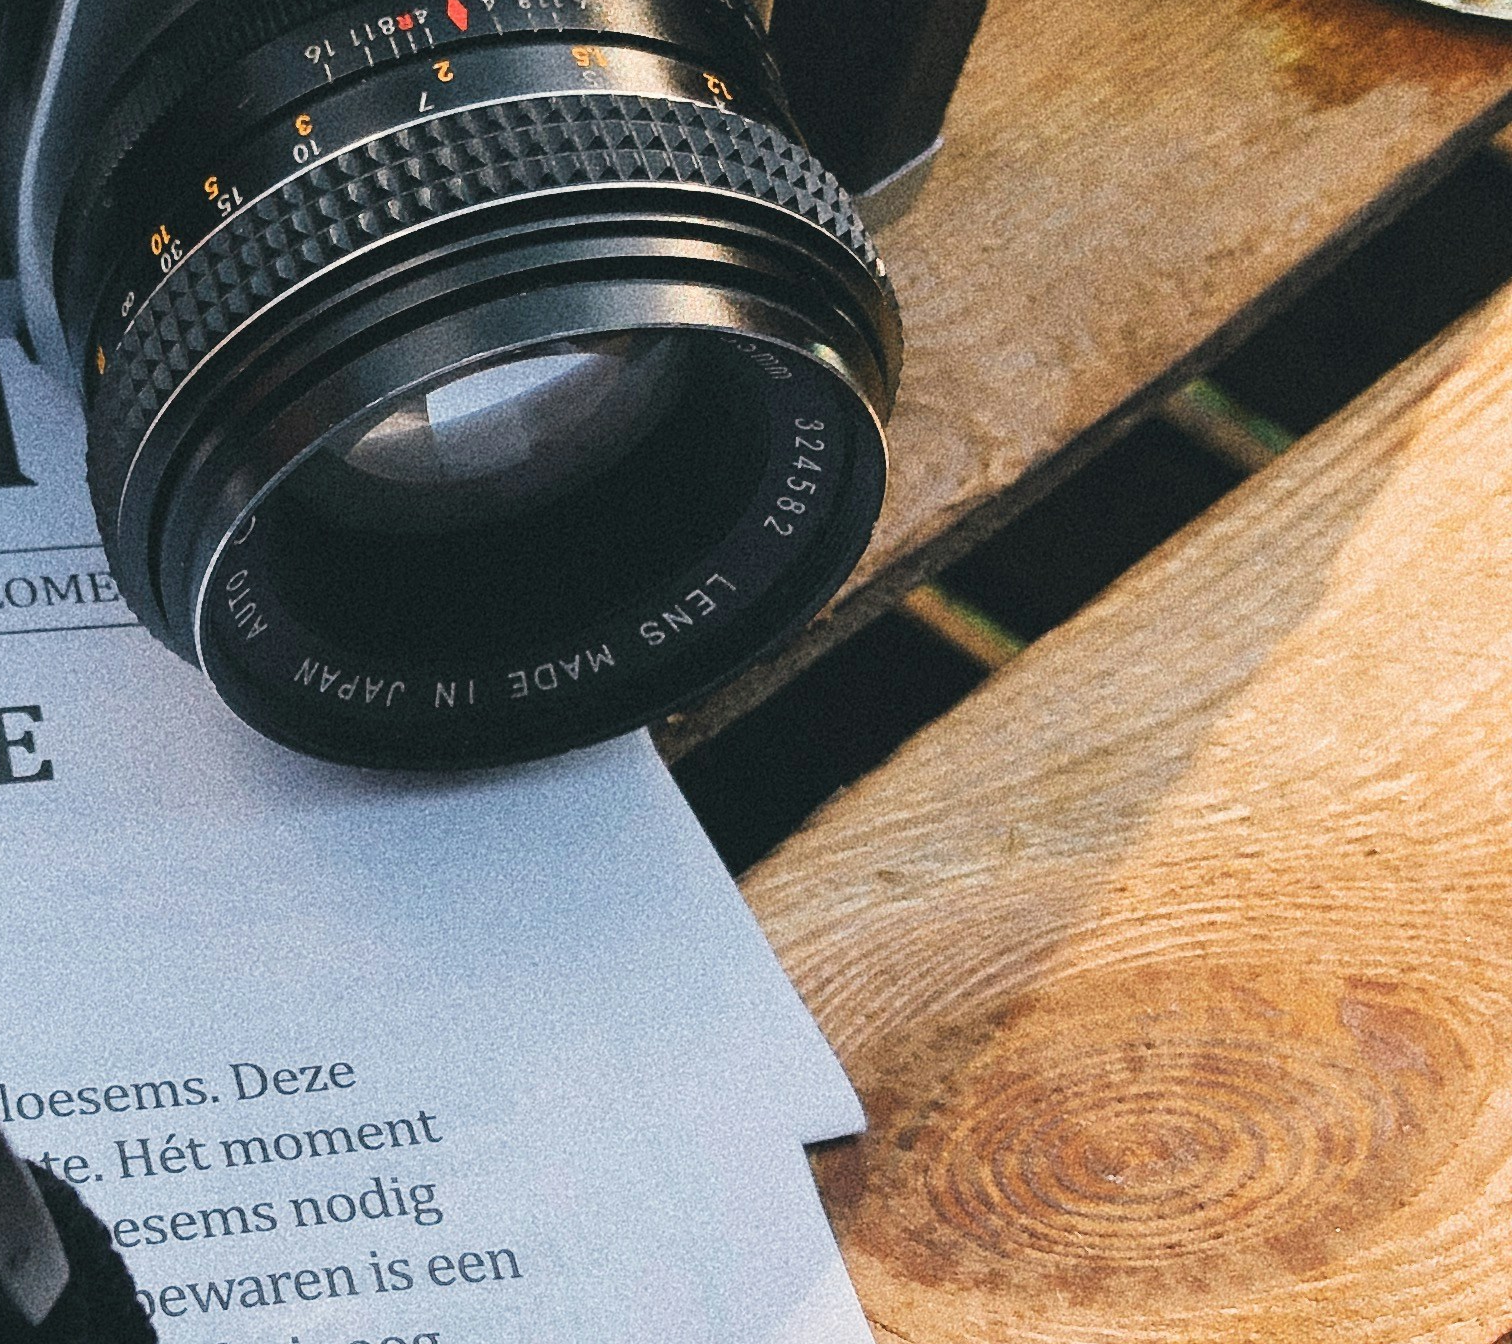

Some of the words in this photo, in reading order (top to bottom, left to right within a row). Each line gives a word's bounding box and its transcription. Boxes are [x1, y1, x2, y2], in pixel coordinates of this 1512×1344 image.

[349, 23, 376, 46] 11
[378, 16, 396, 35] 8
[304, 39, 336, 64] 16
[432, 59, 455, 83] 2
[419, 92, 434, 113] 7
[295, 113, 313, 136] 3
[292, 139, 322, 164] 10
[203, 176, 220, 200] 5
[217, 186, 244, 217] 15
[150, 224, 171, 256] 10
[160, 239, 183, 274] 30
[763, 416, 825, 537] 324582
[226, 569, 268, 640] AUTO
[639, 572, 738, 645] LENS
[293, 658, 406, 706] JAPAN
[506, 642, 616, 698] MADE
[434, 678, 476, 708] IN
[229, 1061, 357, 1102] Deze
[113, 1133, 212, 1180] Hét
[219, 1110, 444, 1168] moment
[288, 1177, 444, 1226] nodig
[368, 1250, 415, 1294] is
[428, 1246, 524, 1287] een
